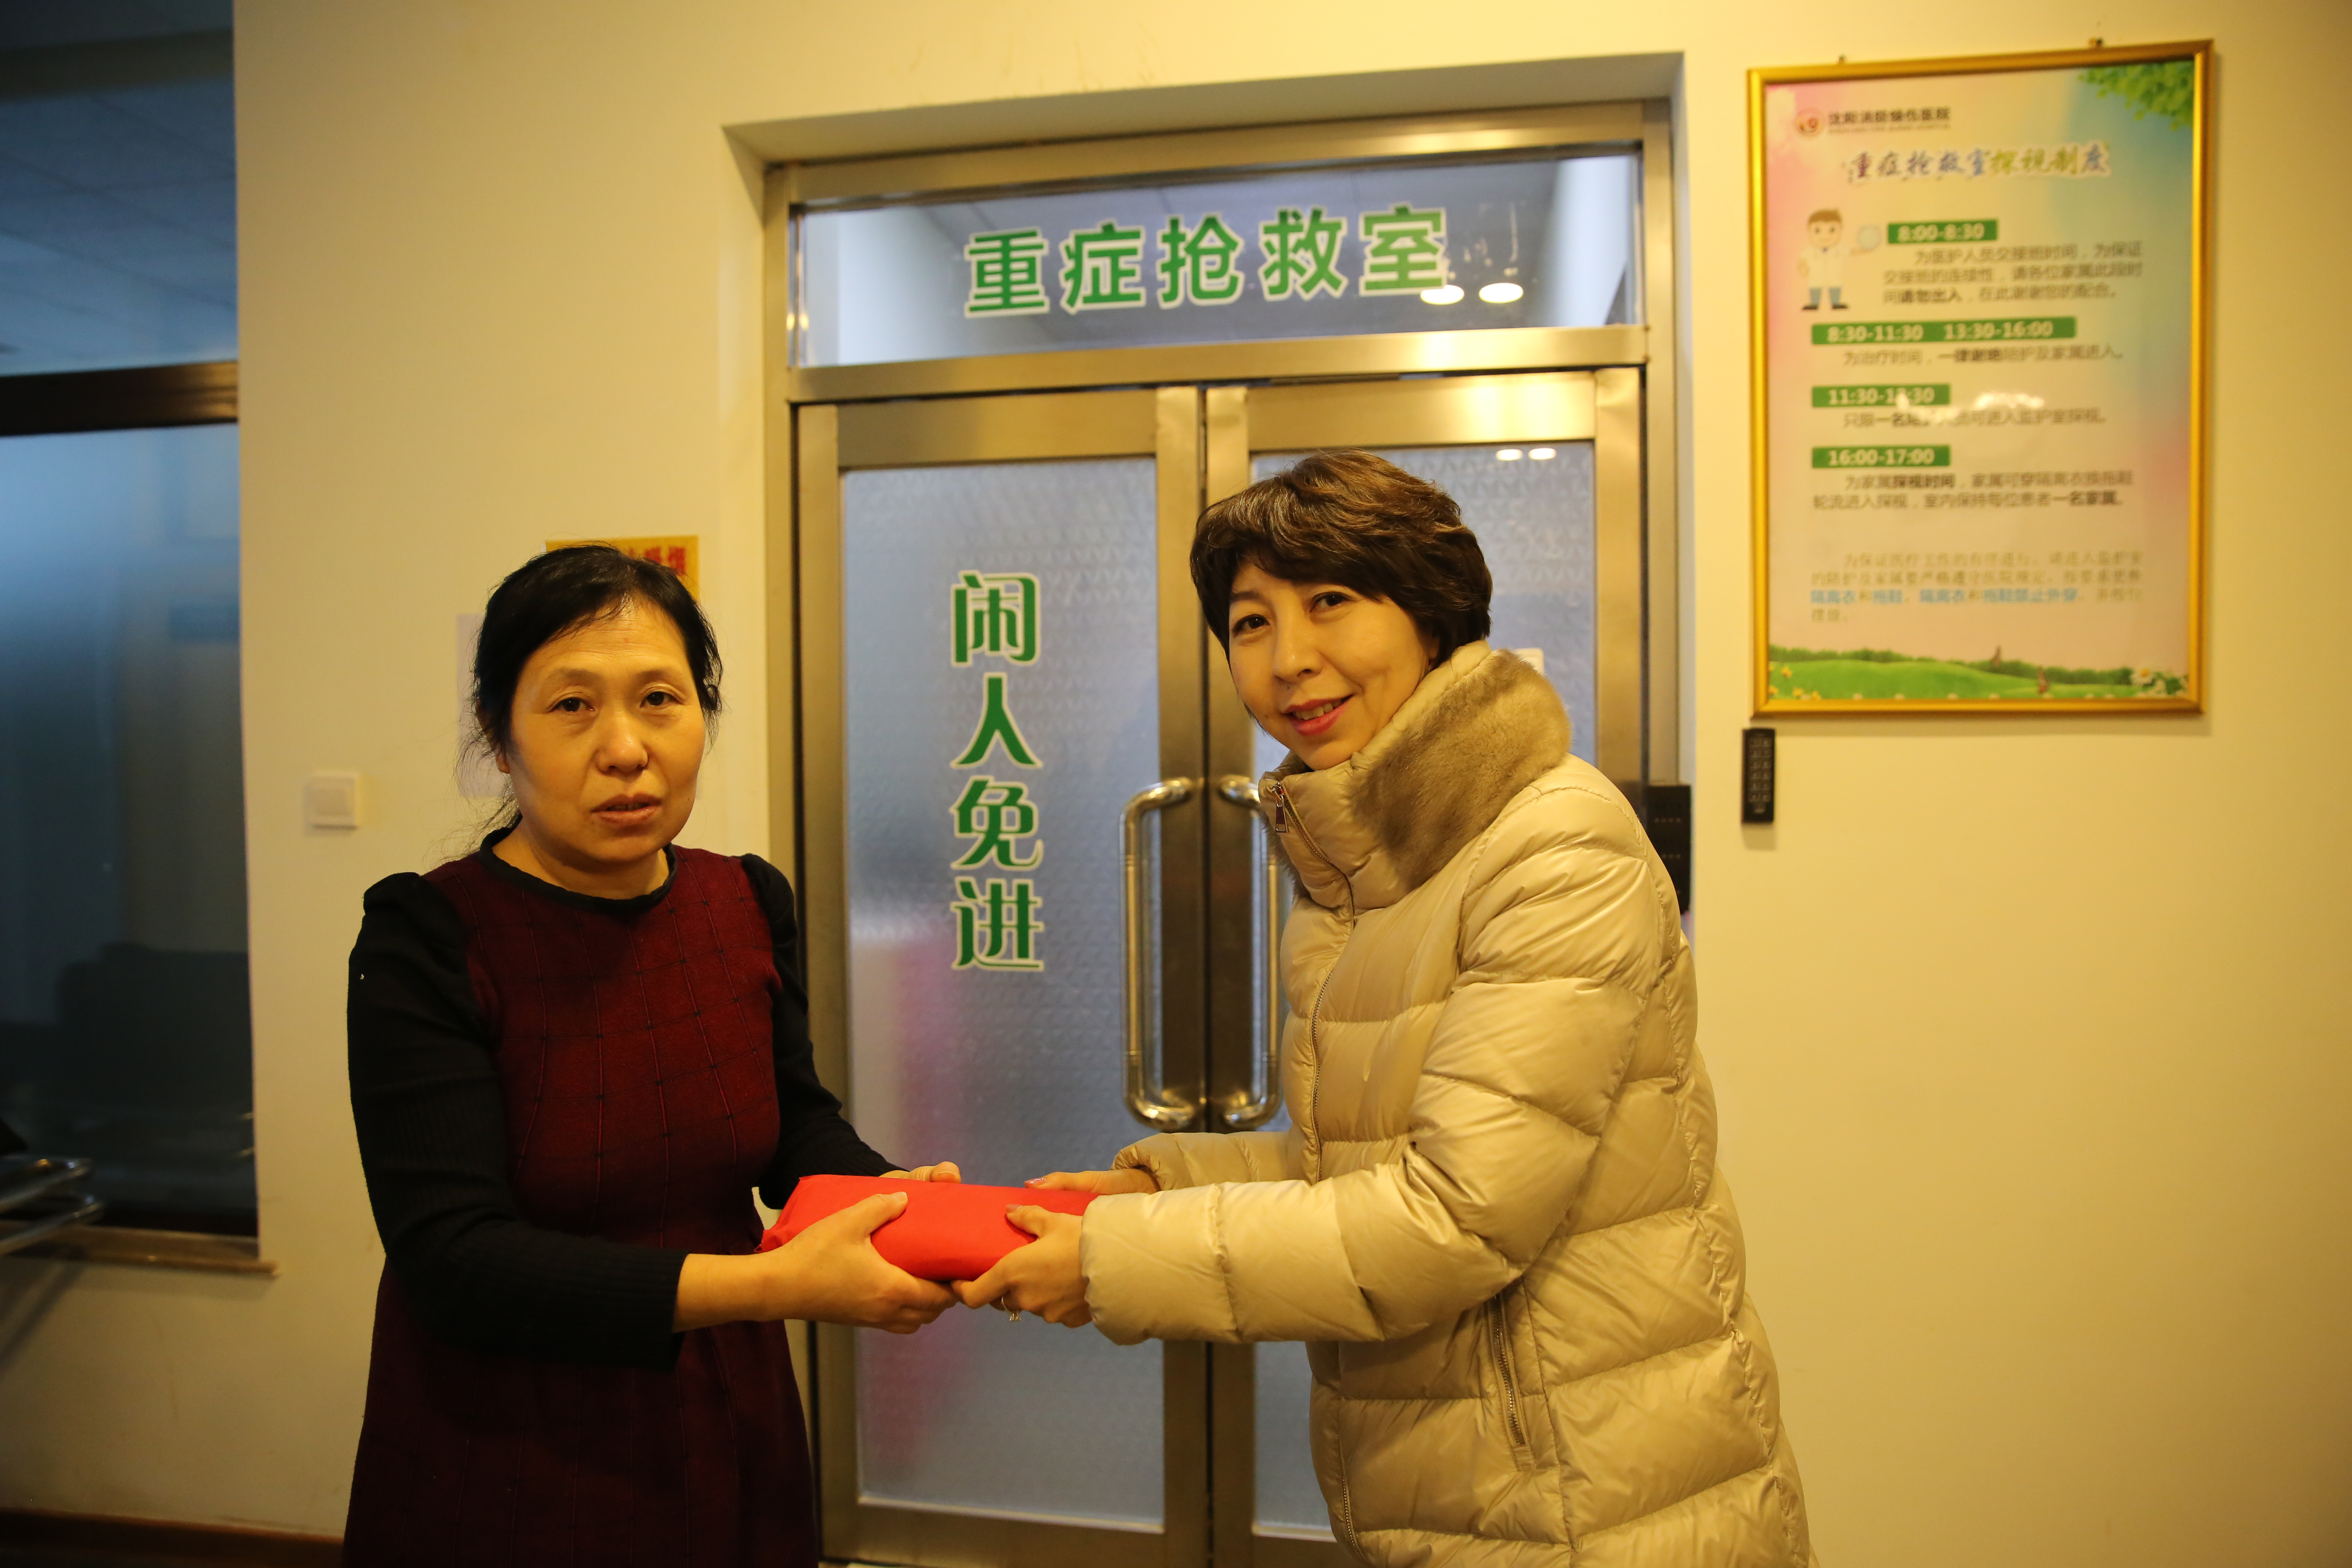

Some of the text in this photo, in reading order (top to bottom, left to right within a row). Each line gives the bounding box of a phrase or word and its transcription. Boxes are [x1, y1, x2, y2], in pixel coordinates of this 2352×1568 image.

[1850, 143, 2109, 180] 重症抢救室探视制度
[1898, 223, 1984, 241] 8:00-8:30
[965, 203, 1448, 318] 重症抢救室
[1827, 321, 2054, 342] 8:30-11:30 13:30-16:00
[1827, 448, 1935, 466] 16:00-17:00
[949, 570, 1045, 971] 闲人免进
